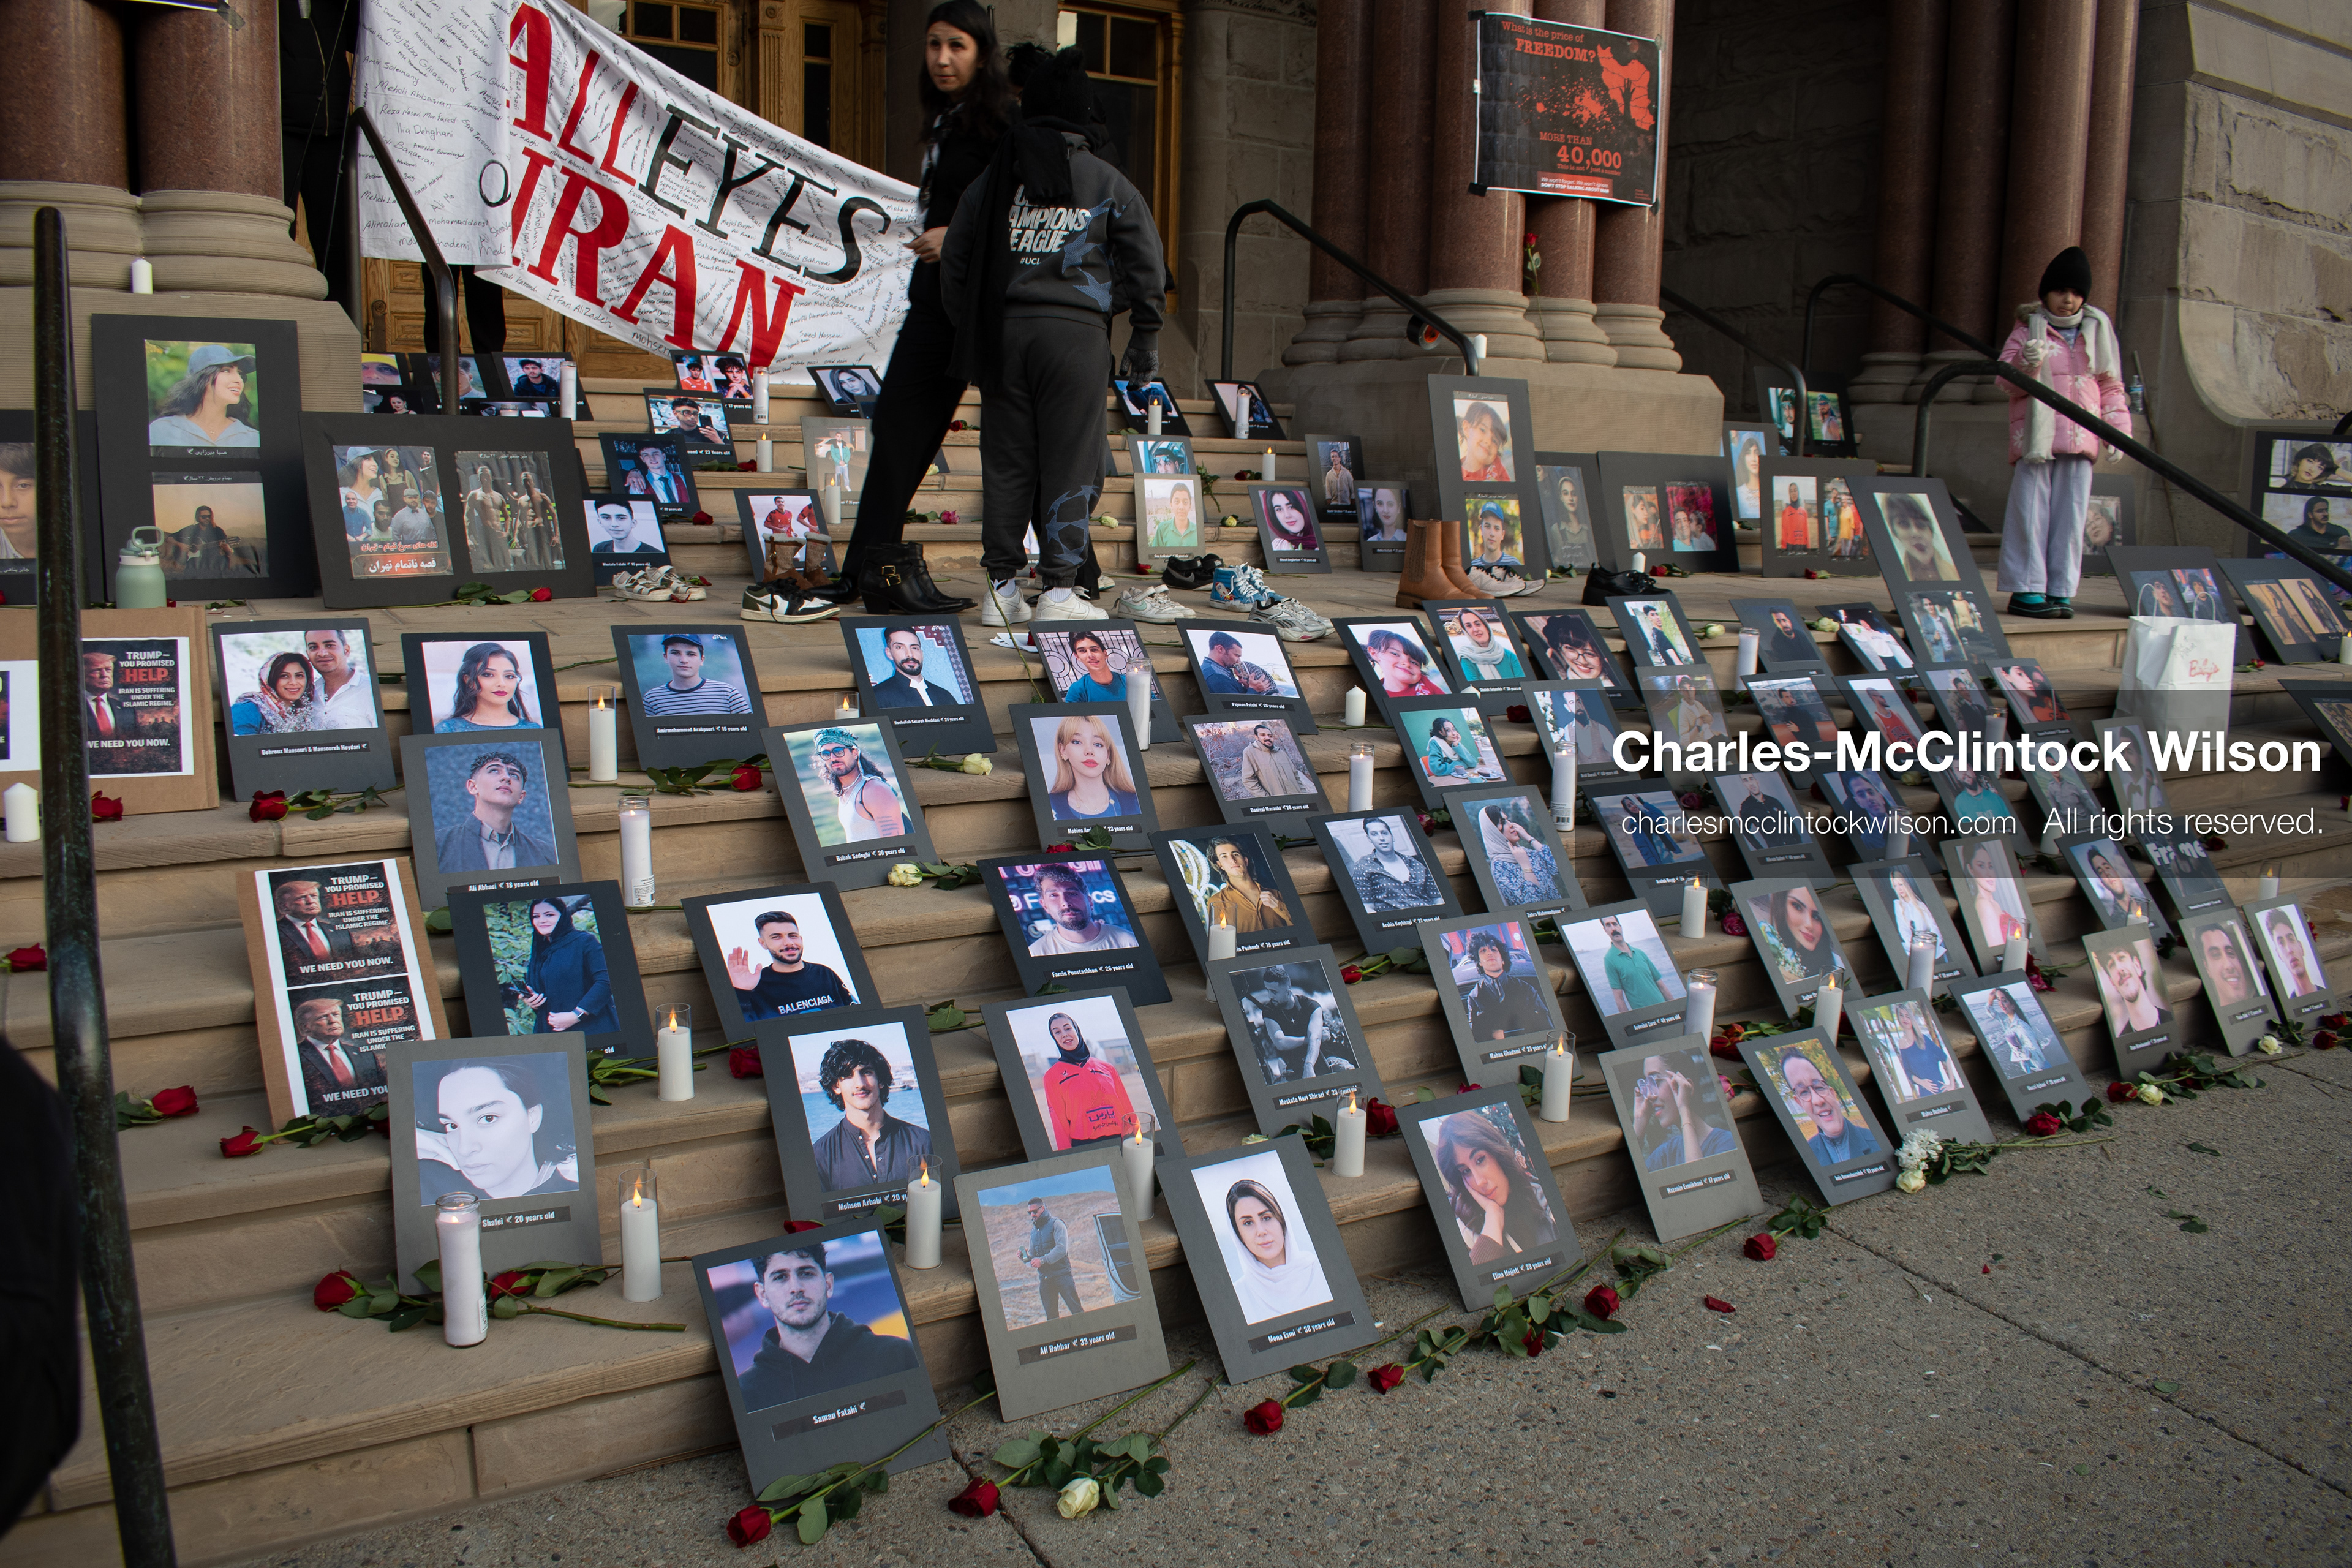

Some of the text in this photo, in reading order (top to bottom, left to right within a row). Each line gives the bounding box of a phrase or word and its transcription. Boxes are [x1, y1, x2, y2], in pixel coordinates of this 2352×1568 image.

[1502, 21, 1585, 42] What is the price of
[1515, 38, 1596, 62] FREEDOM?
[363, 56, 380, 66] Amir
[375, 80, 451, 109] Mehdi Abbasian
[507, 2, 891, 285] ALL EYES
[1540, 131, 1593, 145] MORE THAN
[1557, 145, 1621, 169] 40,000
[511, 146, 805, 369] IRAN
[777, 249, 800, 261] Masoud
[547, 288, 571, 309] Erfan
[361, 543, 379, 552] تهران
[383, 542, 398, 552] قیام
[398, 541, 413, 552] سرخ
[412, 541, 426, 550] های
[369, 558, 437, 573] قصه ناتمام تهران
[125, 668, 168, 682] HELP
[342, 882, 384, 891] PROMISED
[353, 907, 390, 916] SUFFERING
[299, 956, 394, 973] WE NEED YOU NOW.
[347, 997, 410, 1011] YOU PROMISED
[778, 995, 834, 1014] BALENCIAGA
[377, 1025, 416, 1035] SUFFERING
[359, 1043, 386, 1052] ISLAMIC
[322, 1092, 341, 1102] WE
[341, 1088, 369, 1099] NEED
[1279, 1096, 1298, 1106] Mostafa
[1298, 1094, 1309, 1102] Nori
[1308, 1091, 1325, 1100] Shirazi
[1088, 1109, 1115, 1122] پارس
[1666, 1185, 1684, 1194] Nazanin
[838, 1193, 900, 1211] Mohsen Arbabi 20
[482, 1211, 555, 1227] Shafei 20 years old
[1492, 1272, 1504, 1280] Elina
[1504, 1266, 1520, 1277] Hojjati
[1532, 1261, 1544, 1270] years
[1268, 1317, 1335, 1343] Mona Esmi 38 years old
[1049, 1343, 1070, 1353] Rahbar
[1080, 1337, 1088, 1346] 33
[1089, 1334, 1105, 1346] years
[1106, 1331, 1115, 1340] old
[813, 1405, 858, 1424] Saman Fatahi
